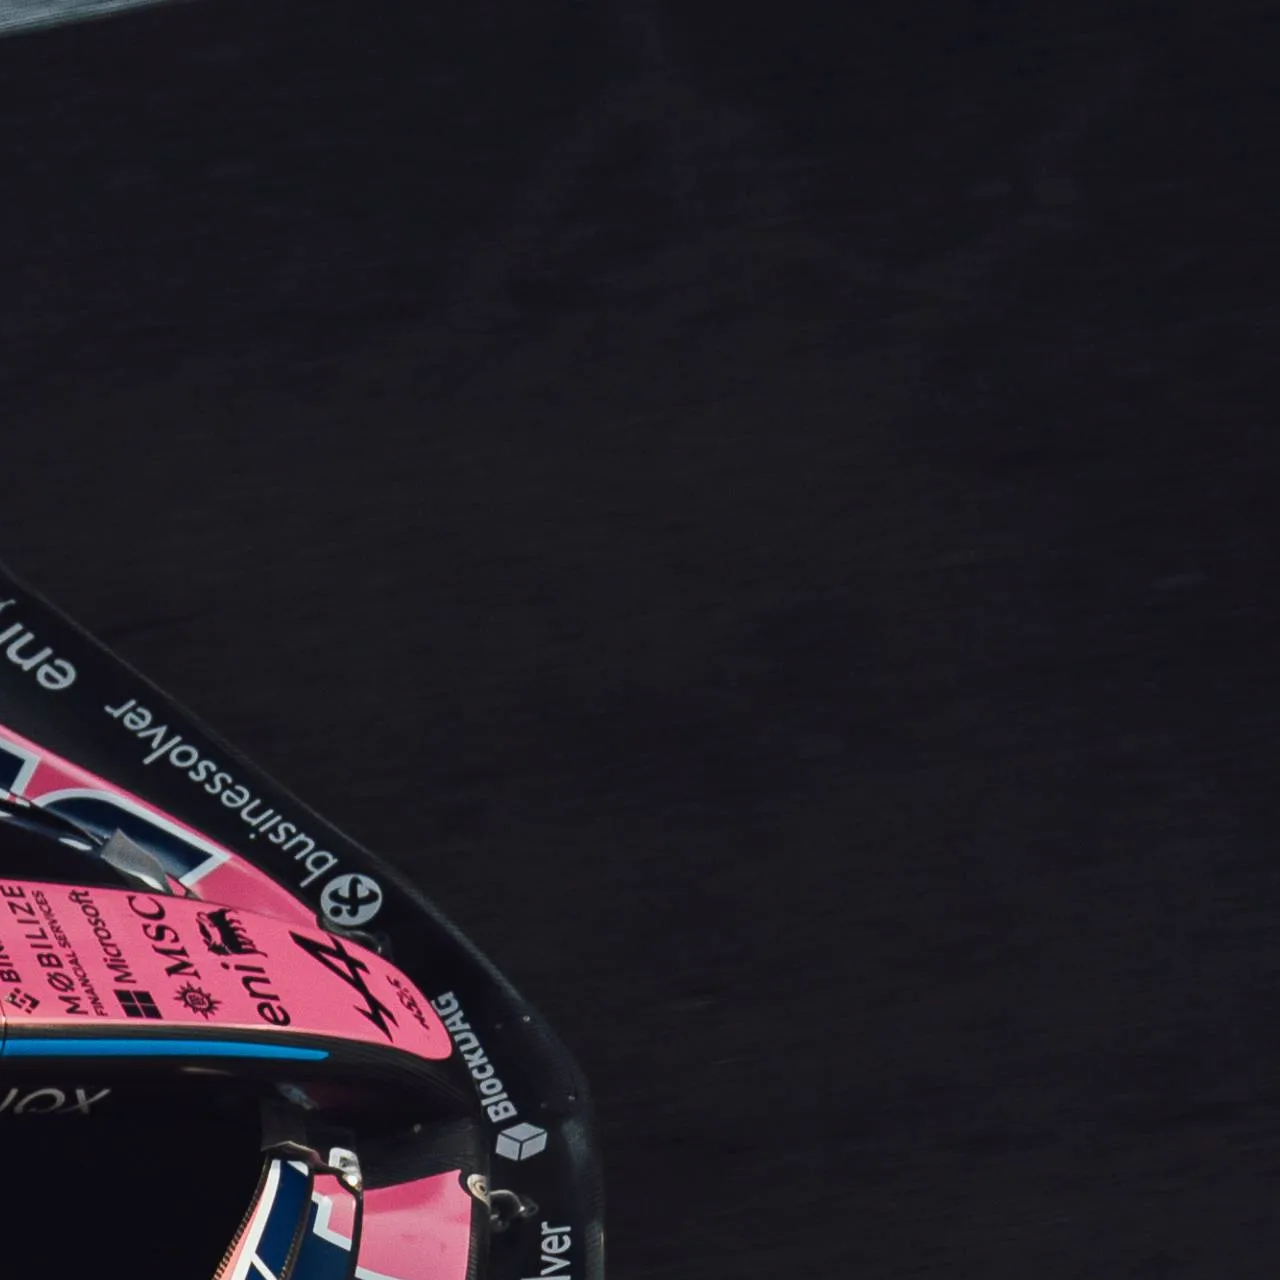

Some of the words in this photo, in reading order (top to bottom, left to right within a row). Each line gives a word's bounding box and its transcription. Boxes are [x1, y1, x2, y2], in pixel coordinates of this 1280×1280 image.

[105, 699, 338, 888] businessolver
[31, 889, 73, 950] SERVICES
[67, 889, 137, 985] Microsoft
[127, 894, 203, 981] MSC
[65, 950, 109, 1018] FINANCIAL
[221, 964, 291, 1028] eni
